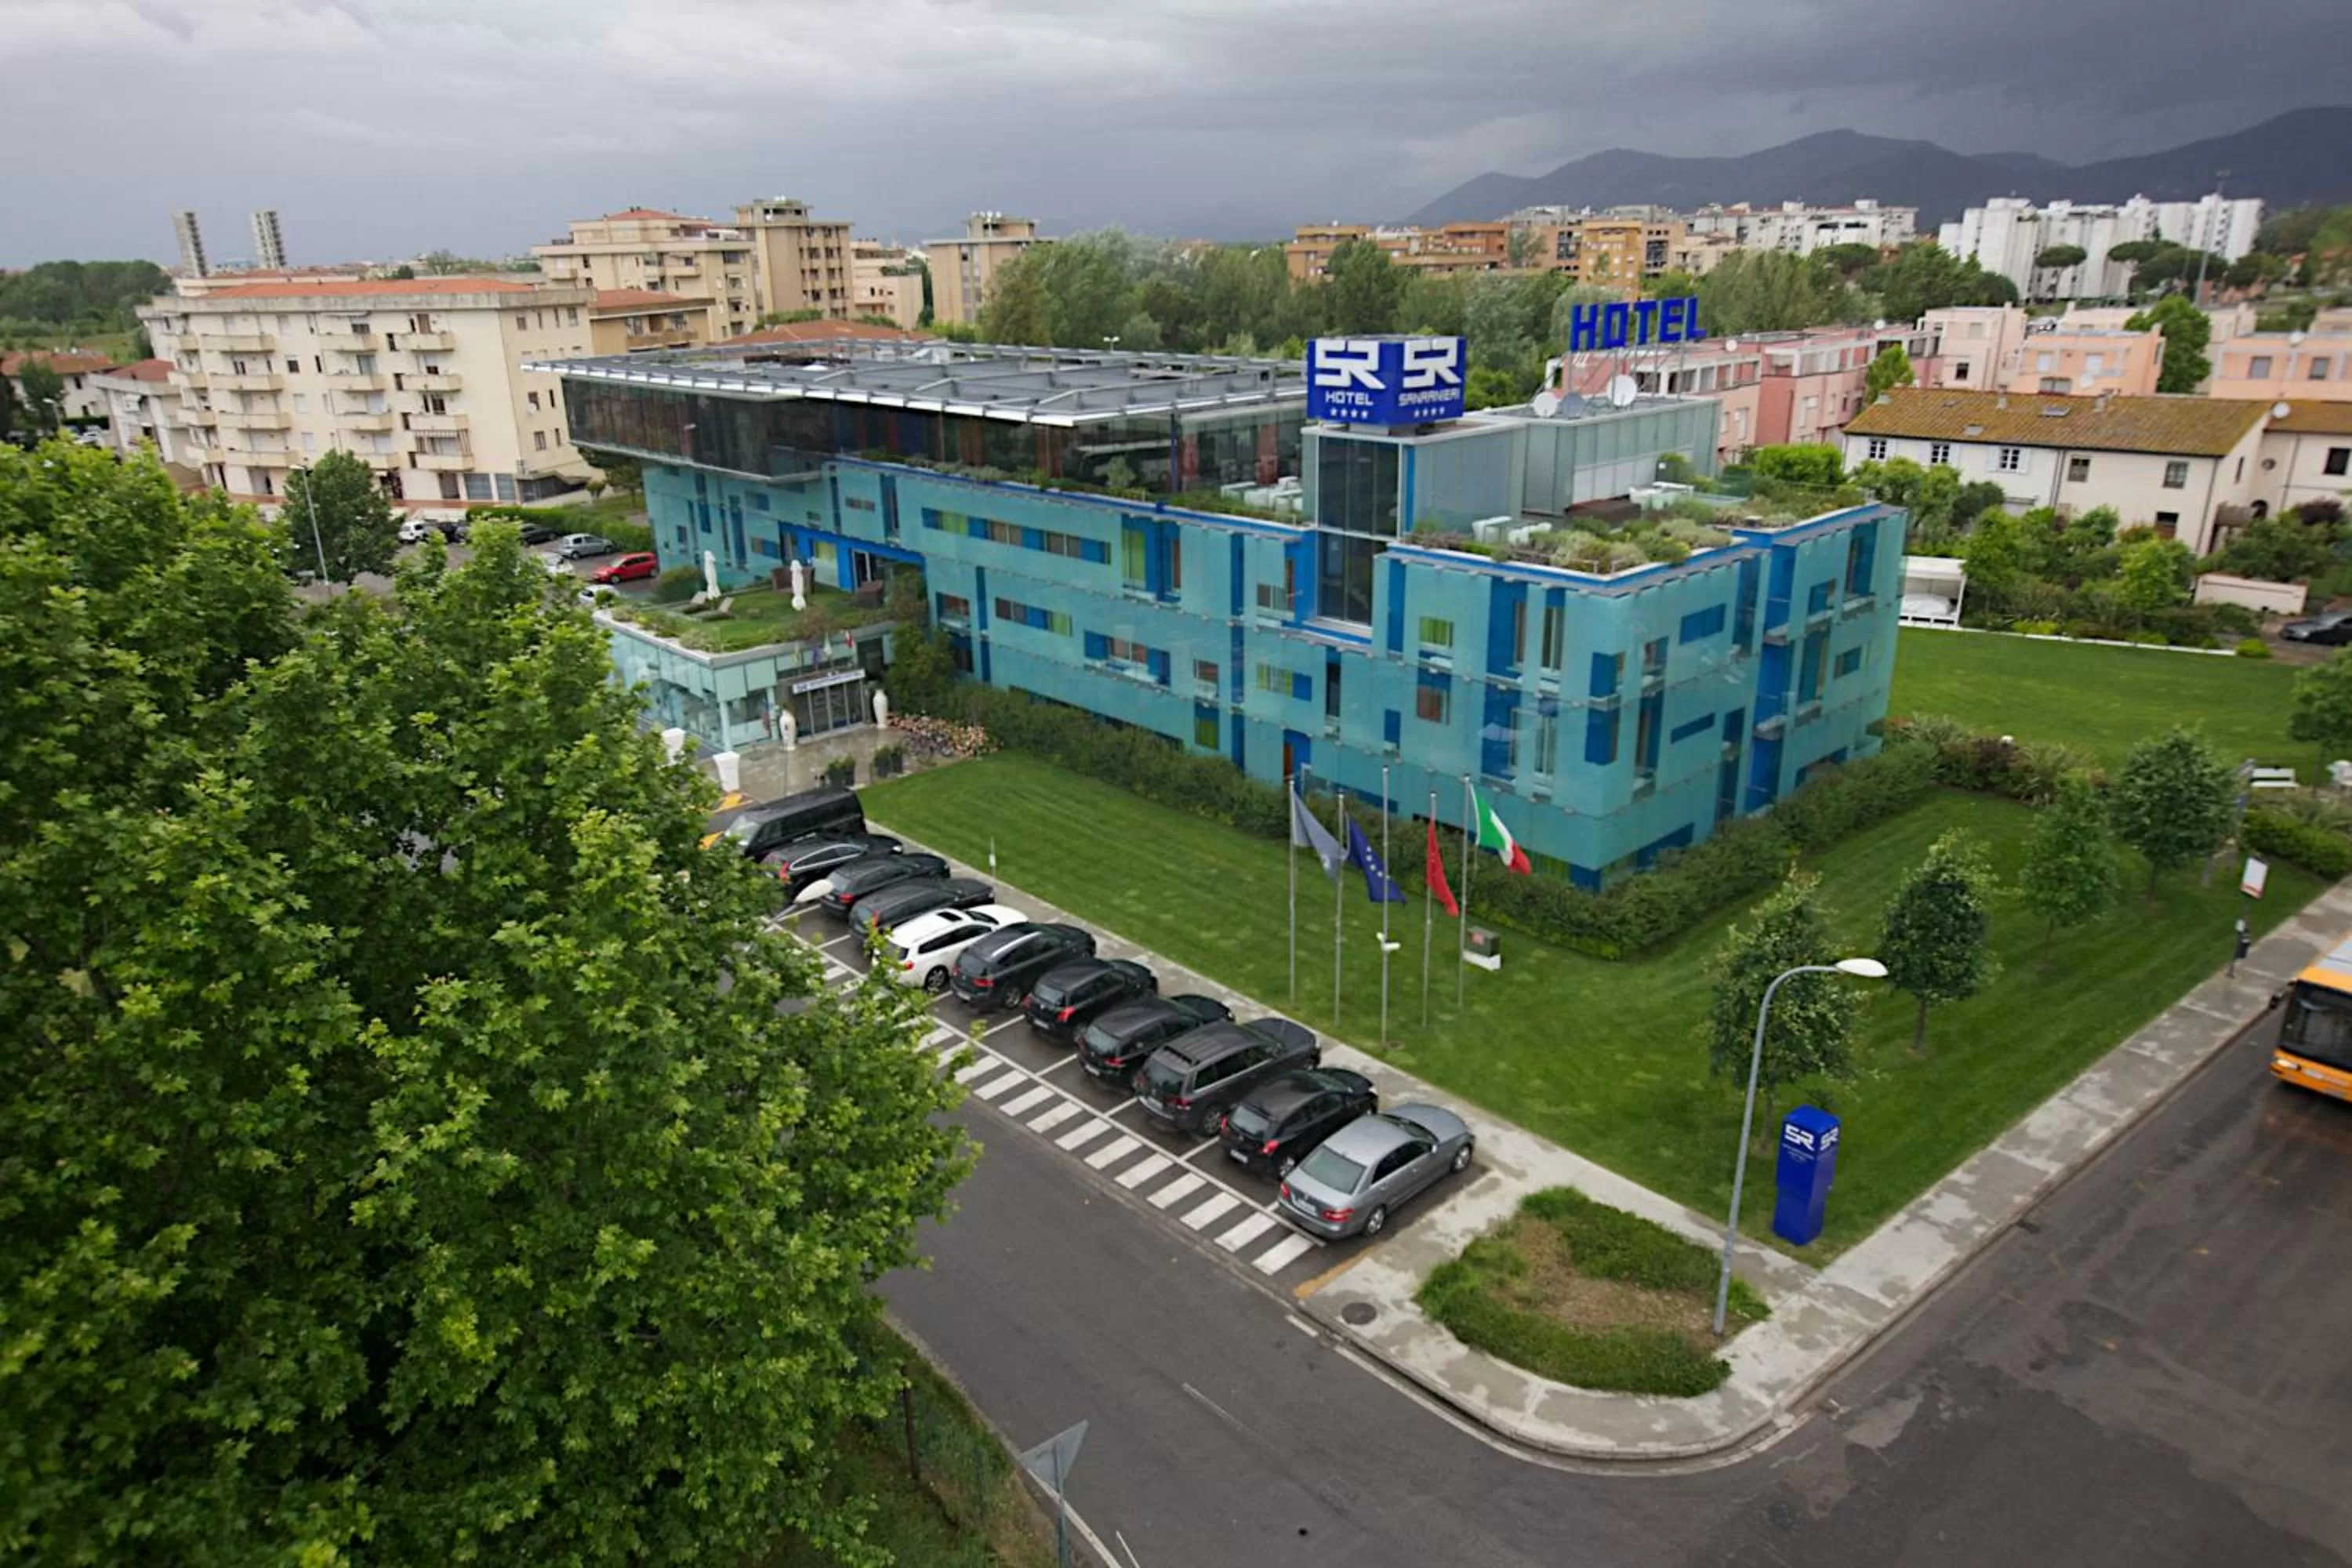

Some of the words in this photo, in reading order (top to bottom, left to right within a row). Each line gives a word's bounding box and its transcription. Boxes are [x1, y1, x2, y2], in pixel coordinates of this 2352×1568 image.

[1570, 296, 1707, 352] HOTEL
[1316, 339, 1386, 389] SR
[1403, 338, 1461, 388] SR
[1325, 390, 1374, 406] HOTEL
[1784, 1123, 1816, 1152] SR
